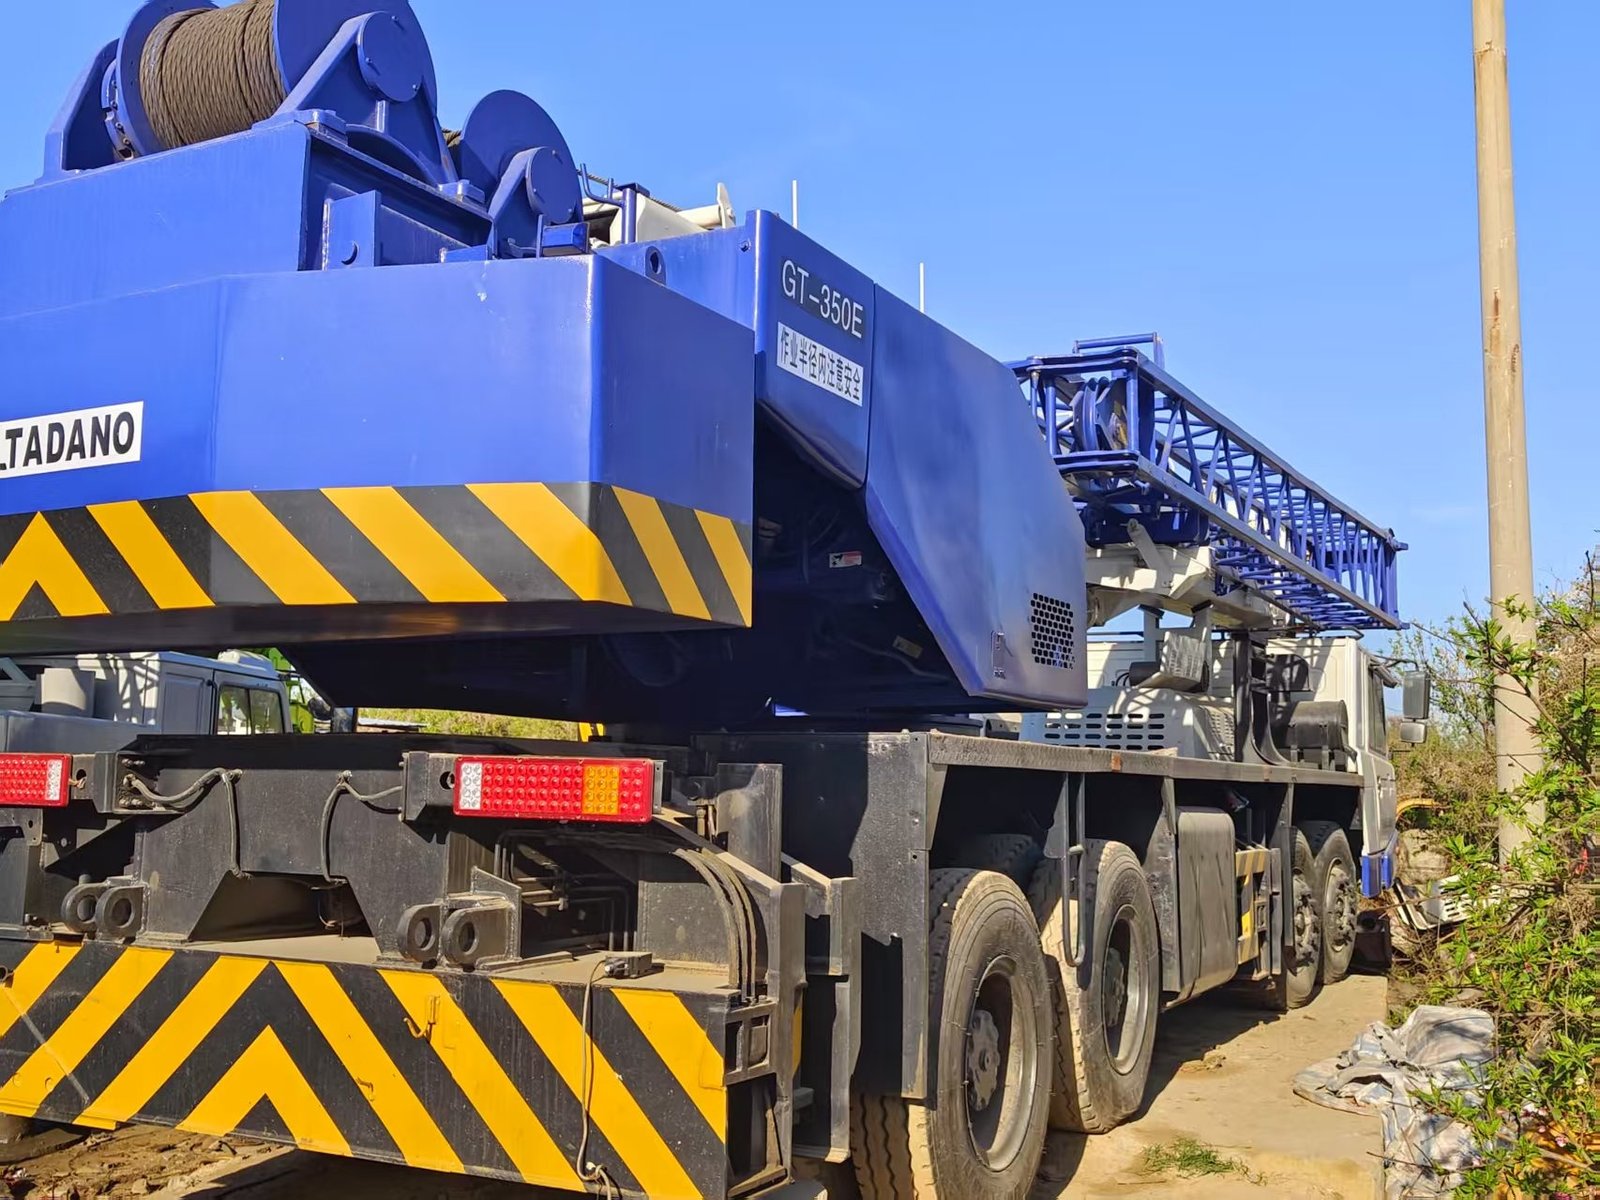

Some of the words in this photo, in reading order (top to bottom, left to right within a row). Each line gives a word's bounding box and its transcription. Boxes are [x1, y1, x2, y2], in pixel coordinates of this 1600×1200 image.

[782, 260, 863, 339] GT-350E
[780, 326, 861, 400] 作业半径内注意安全
